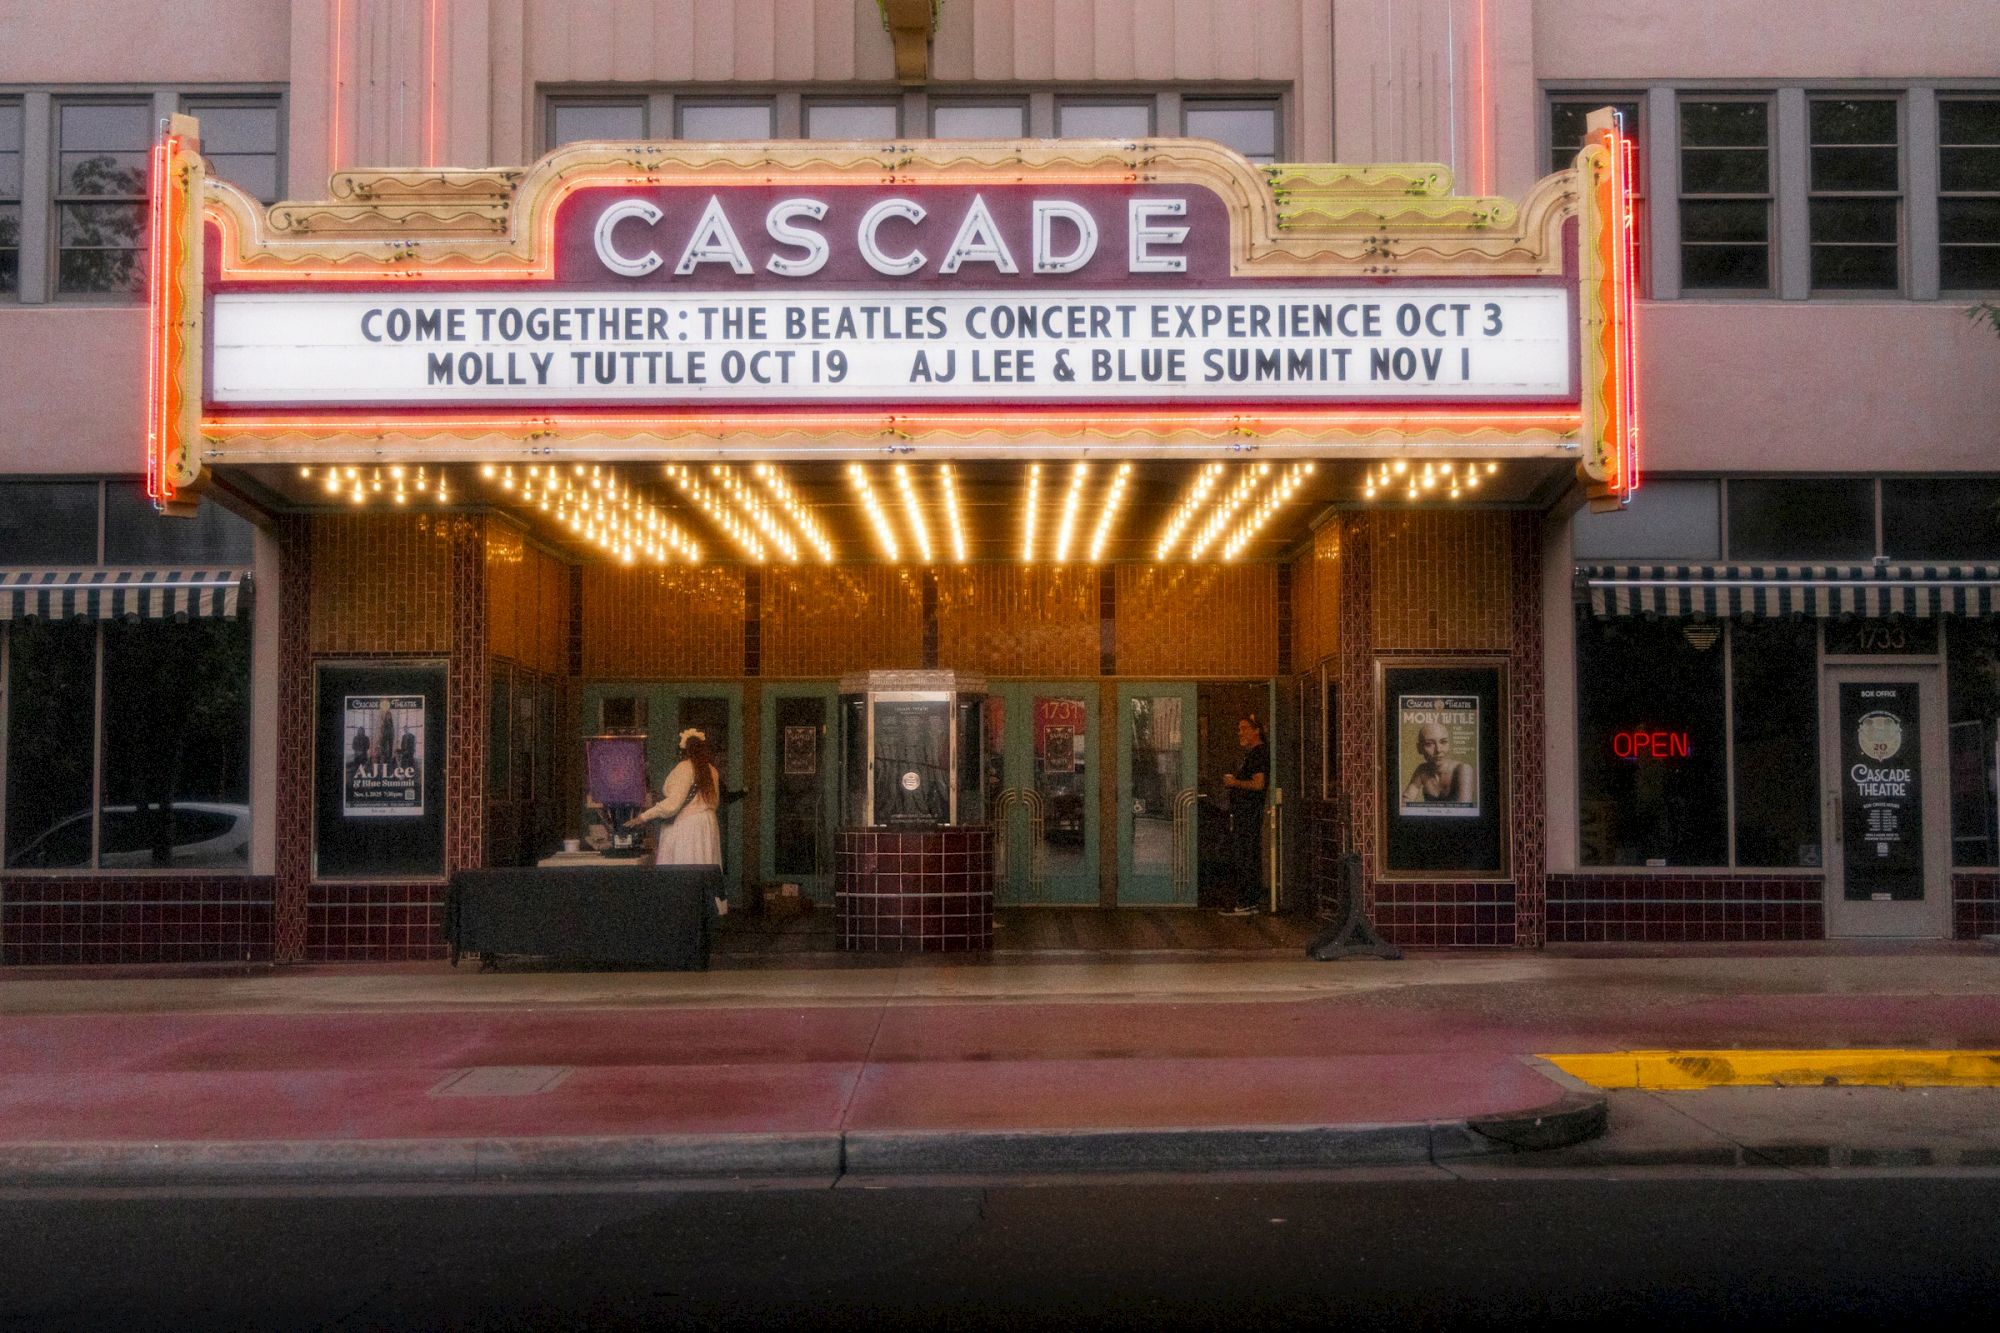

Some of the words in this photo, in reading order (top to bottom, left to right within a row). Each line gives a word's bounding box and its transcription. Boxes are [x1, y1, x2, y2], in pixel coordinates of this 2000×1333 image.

[593, 194, 1190, 277] CASCADE
[361, 307, 465, 343] COME
[698, 306, 767, 341] THE
[785, 305, 948, 341] BEATLES
[965, 304, 1137, 340] CONCERT
[1150, 304, 1382, 339] EXPERIENCE
[1396, 303, 1471, 338] OCT
[1482, 302, 1503, 337] 3
[426, 350, 553, 386] MOLLY
[571, 350, 706, 386] TUTTLE
[720, 350, 796, 384] OCT
[810, 349, 849, 385] 19
[909, 348, 956, 383] AJ
[971, 348, 1036, 383] LEE
[1052, 348, 1076, 383] &
[1091, 348, 1187, 383] BLUE
[1203, 347, 1352, 383] SUMMIT
[1369, 347, 1443, 383] NOV
[1857, 626, 1906, 649] 1733
[1861, 690, 1875, 698] BOX
[1875, 690, 1896, 698] OFFICE
[1041, 702, 1078, 720] 1731
[1403, 711, 1439, 725] MOLLY
[1442, 711, 1475, 725] TUTTLE
[1613, 732, 1689, 758] OPEN
[353, 763, 379, 779] AJ
[382, 763, 415, 779] Lee
[1851, 763, 1912, 783] CASCADE
[362, 779, 381, 788] Blue
[382, 779, 415, 788] Summit
[1857, 783, 1907, 797] THEATRE
